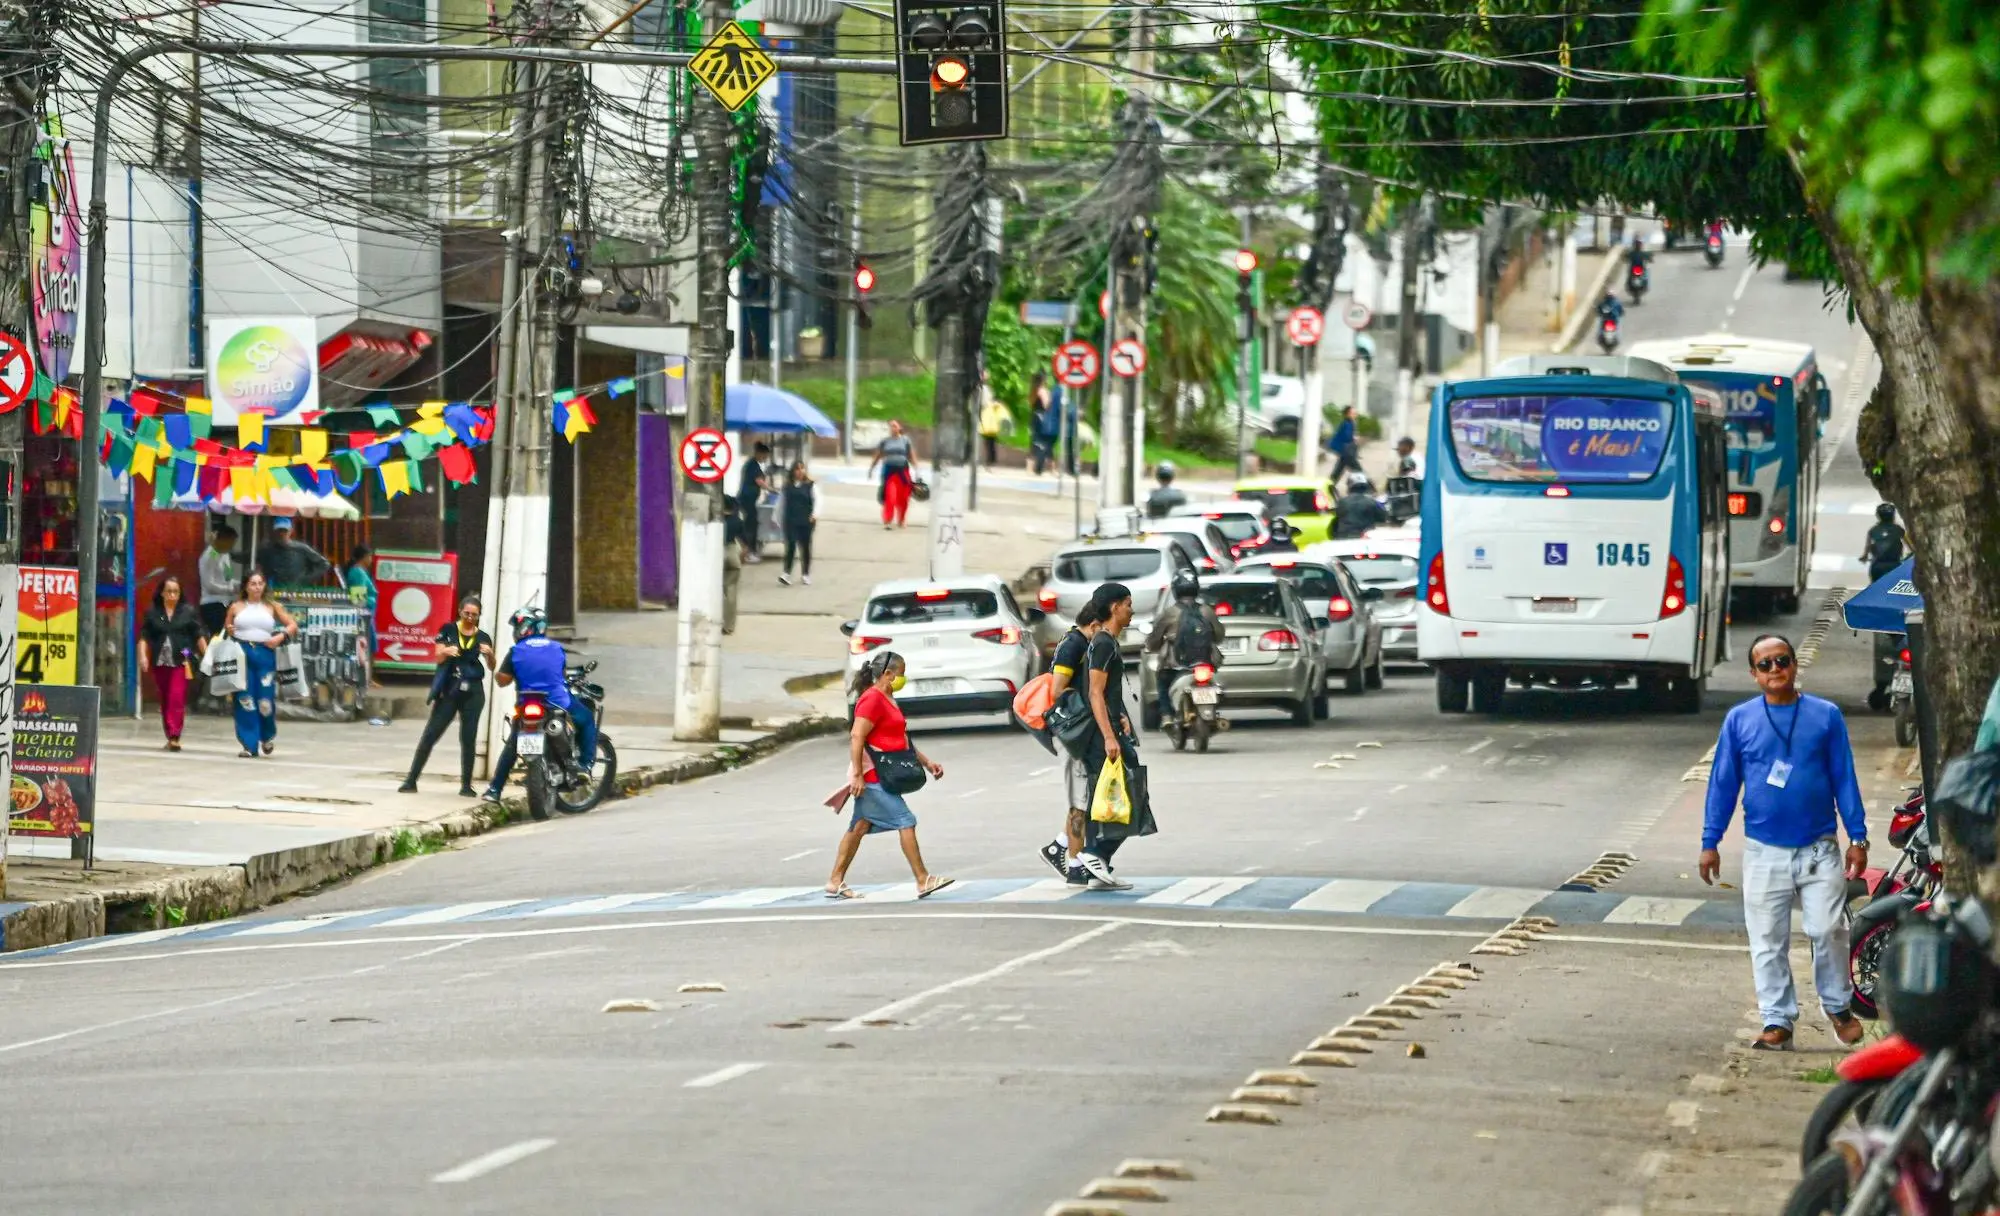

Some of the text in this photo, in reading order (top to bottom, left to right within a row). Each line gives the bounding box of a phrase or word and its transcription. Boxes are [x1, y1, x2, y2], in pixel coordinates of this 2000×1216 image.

[38, 255, 79, 319] Simão
[233, 377, 294, 396] Simão
[1553, 417, 1661, 432] RIO BRANCO
[1584, 432, 1642, 457] Mais!
[1596, 543, 1650, 567] 1945
[25, 745, 74, 759] Cheiro
[14, 764, 47, 773] VARIADO
